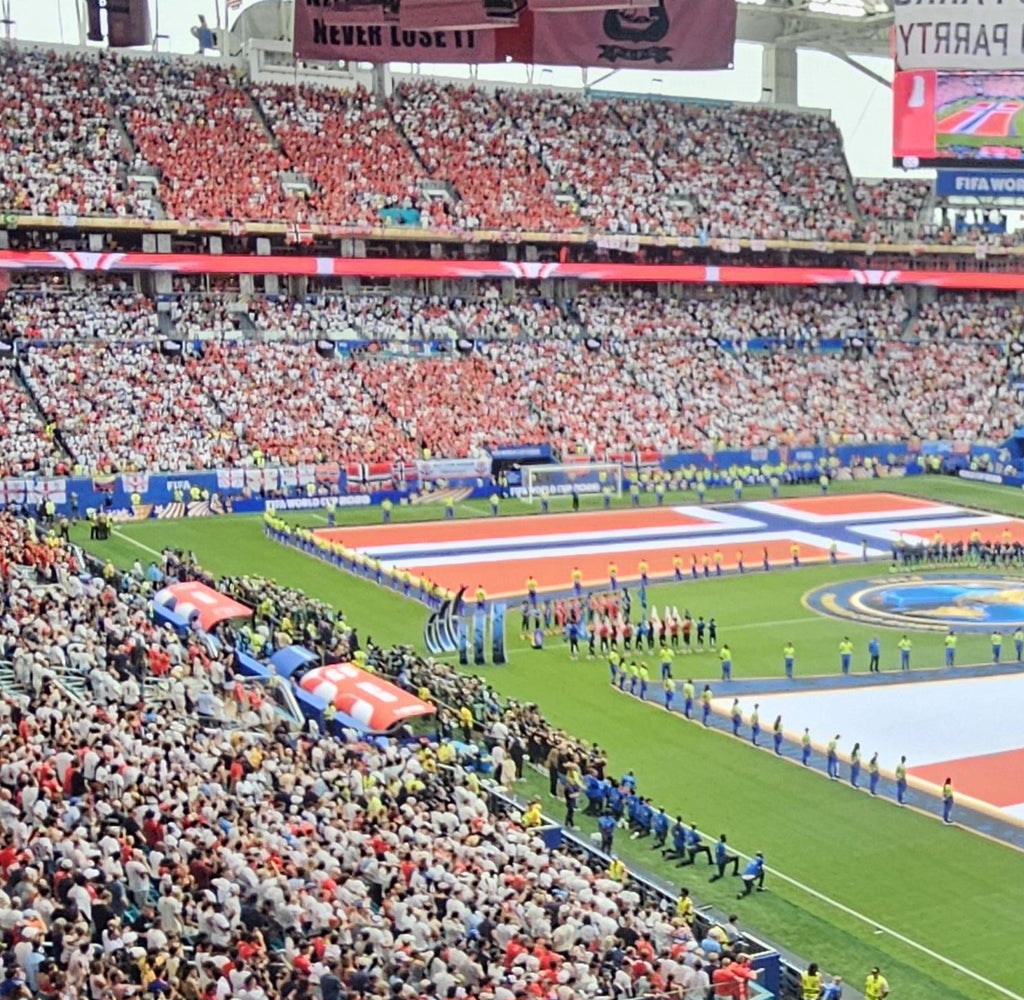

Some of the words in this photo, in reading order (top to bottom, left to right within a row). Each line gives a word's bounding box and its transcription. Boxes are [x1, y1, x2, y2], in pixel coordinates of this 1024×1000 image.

[313, 18, 382, 46] NEVER
[390, 25, 446, 48] LOSE
[955, 177, 990, 191] FIFA
